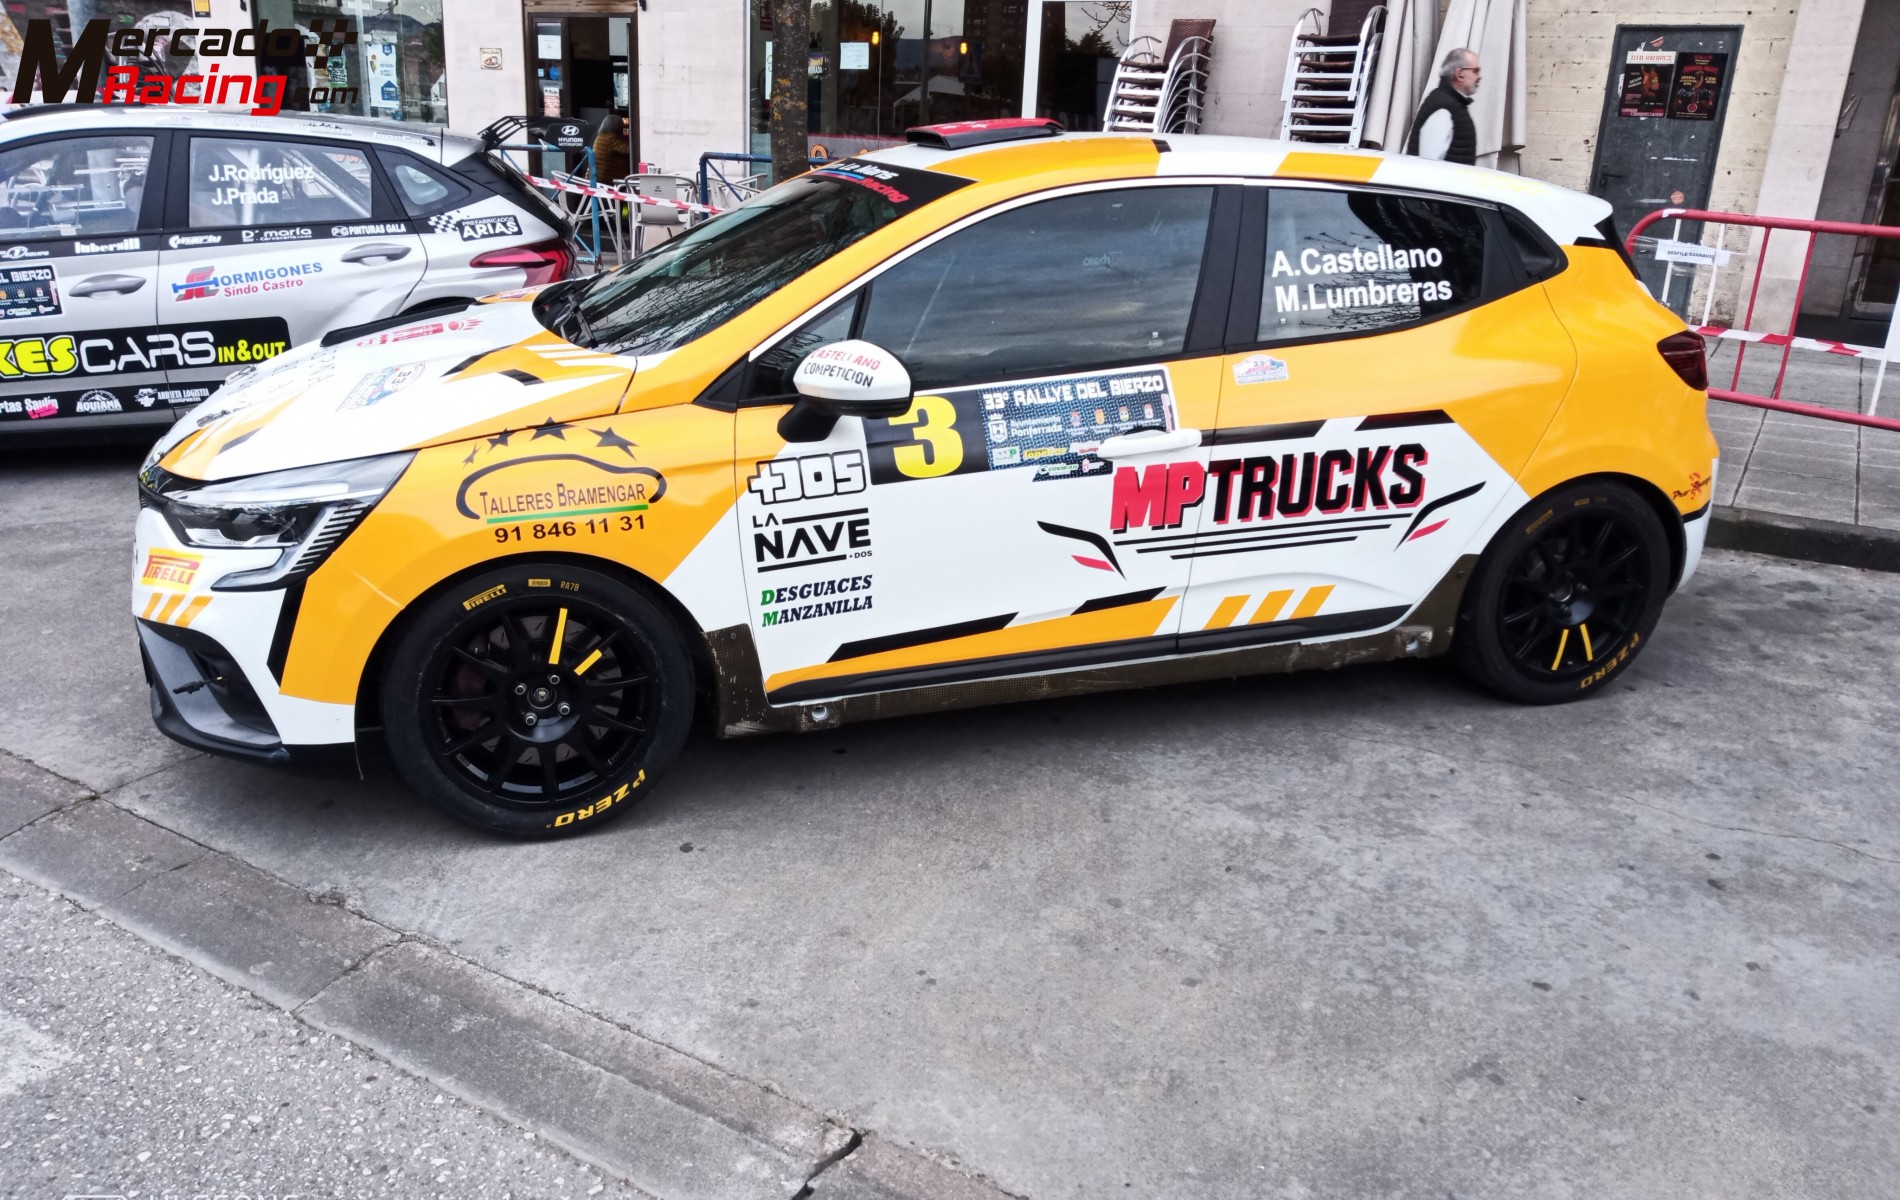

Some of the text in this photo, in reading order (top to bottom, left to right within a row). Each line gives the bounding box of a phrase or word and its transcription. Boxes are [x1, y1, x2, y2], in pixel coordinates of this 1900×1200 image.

[209, 163, 314, 185] J.Rodríguez
[211, 187, 279, 206] J.Prada
[861, 177, 909, 203] Racing
[348, 224, 385, 235] PINTURAS
[385, 223, 406, 233] GALA
[462, 216, 514, 227] PREFABRICADOS
[463, 221, 518, 239] ARIAS
[1271, 244, 1443, 278] A.Castellano
[10, 269, 53, 283] BIERZO
[224, 278, 304, 298] Sindo Castro
[1275, 279, 1453, 313] M.Lumbreras
[79, 330, 215, 374] CARS
[1014, 385, 1073, 407] RALLYE
[1075, 381, 1107, 400] DEL
[1110, 375, 1165, 396] BIERZO
[1010, 416, 1062, 428] Ayuntamiento
[1011, 424, 1063, 438] Ponferrada
[888, 396, 964, 479] 3
[494, 514, 645, 543] 91 846 11 31
[752, 512, 779, 528] LA
[753, 517, 871, 563] NAVE
[144, 554, 199, 585] PIRELLI
[463, 583, 507, 611] PIRELLI
[554, 782, 630, 828] ZERO
